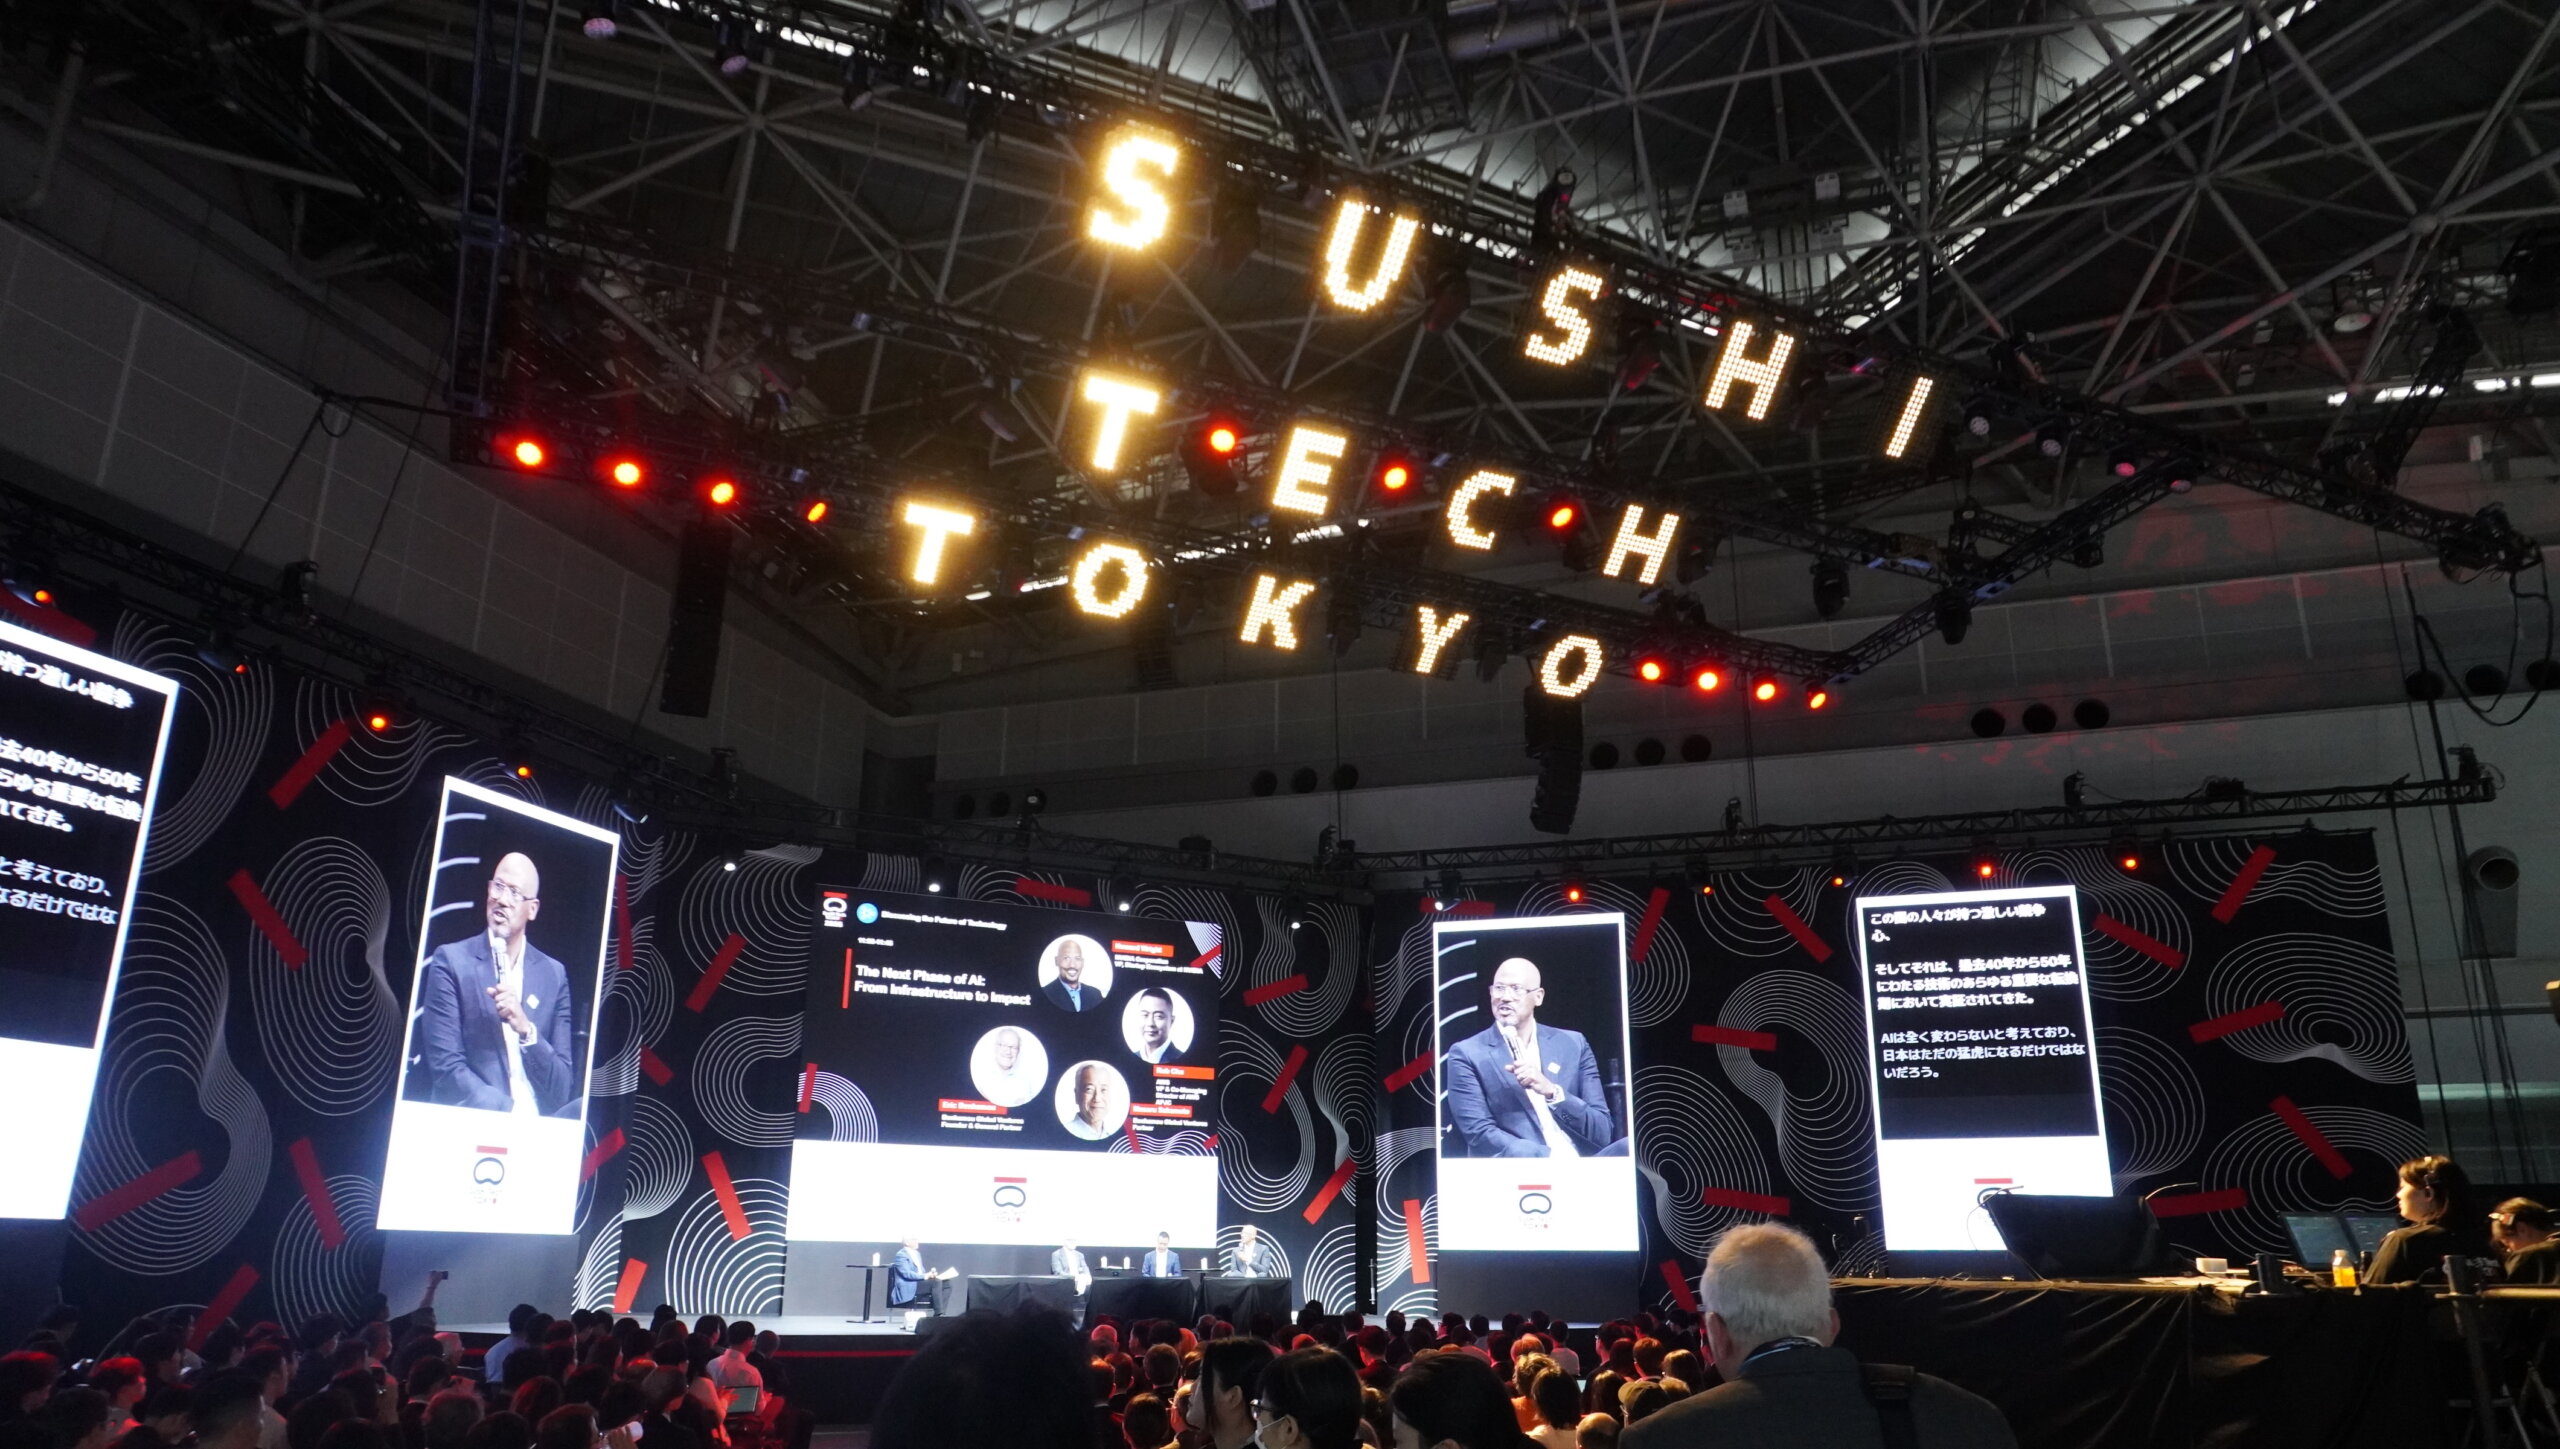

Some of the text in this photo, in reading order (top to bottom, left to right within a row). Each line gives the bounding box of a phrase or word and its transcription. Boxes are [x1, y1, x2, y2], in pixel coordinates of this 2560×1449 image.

[1085, 127, 1934, 459] SUSHI
[1081, 372, 1680, 585] TECH
[902, 500, 1604, 698] TOKYO
[855, 964, 986, 987] The Next Phase of AI:
[854, 981, 1031, 1006] From Infrastructure to Impact
[1880, 1025, 2077, 1045] AIは全く変わらないと考えており、
[1883, 1066, 1940, 1080] いだろう。
